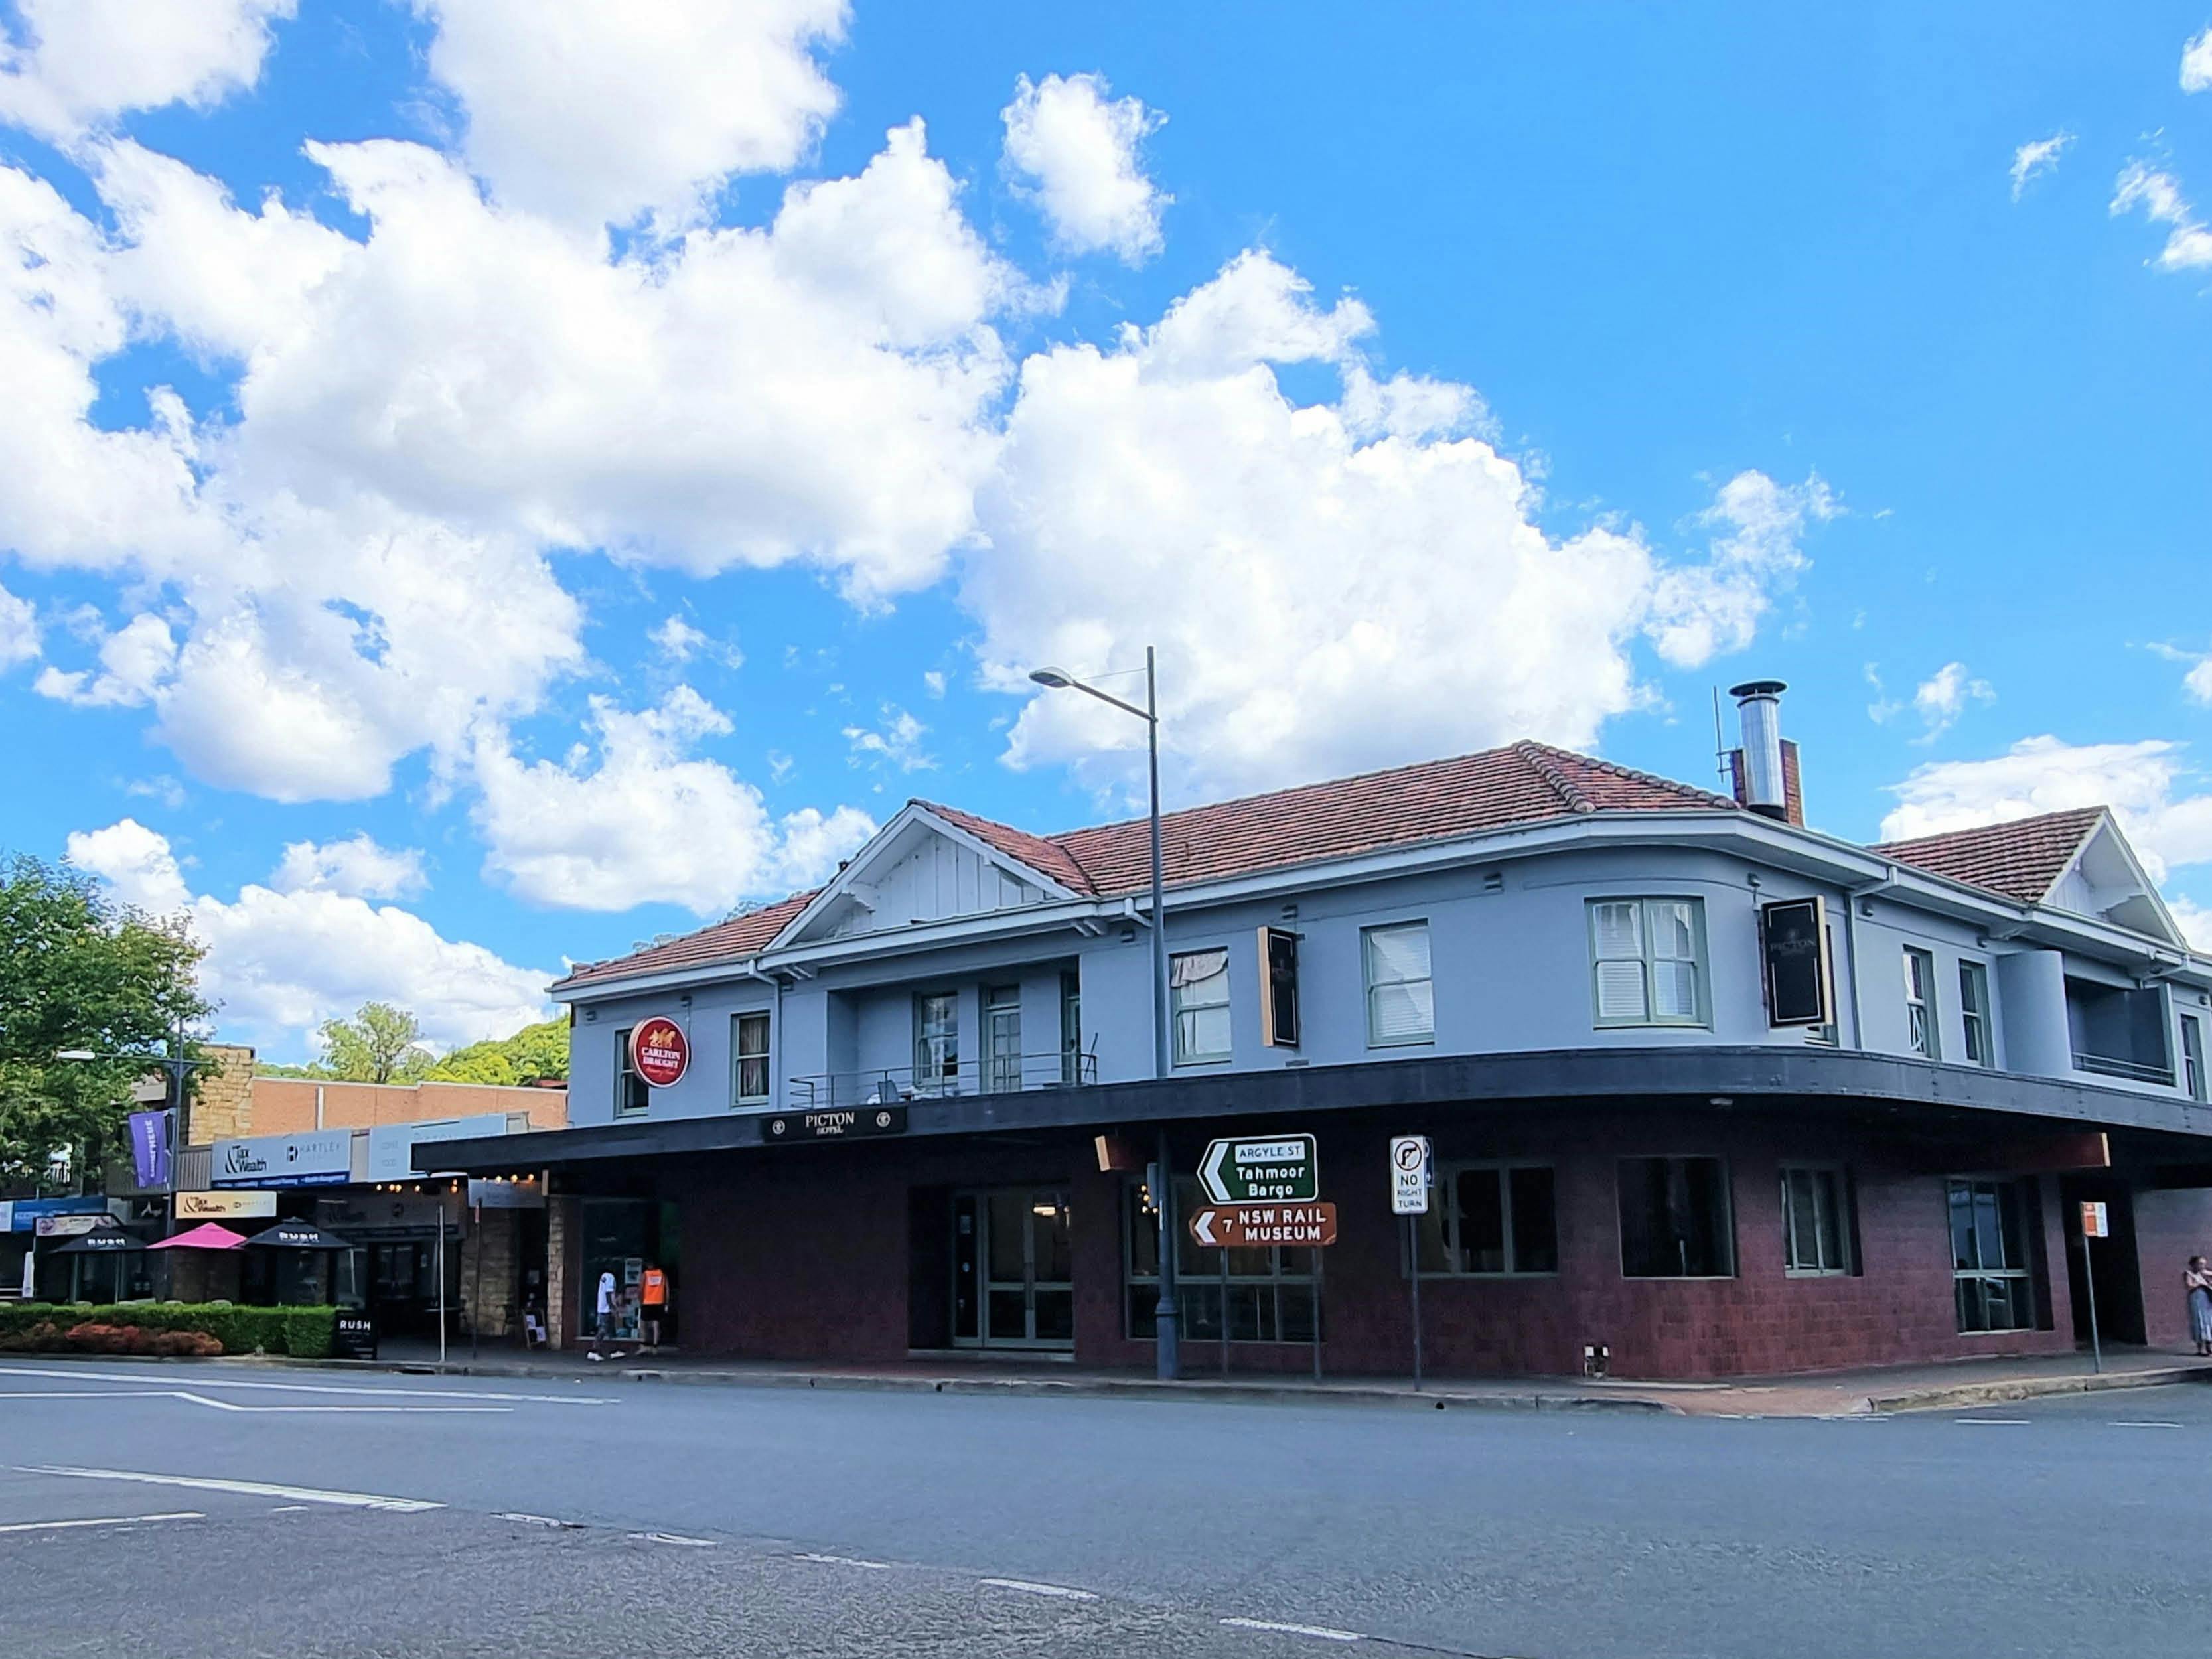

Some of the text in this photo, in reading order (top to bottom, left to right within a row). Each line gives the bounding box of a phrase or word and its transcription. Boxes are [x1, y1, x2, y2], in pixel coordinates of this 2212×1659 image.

[641, 1046, 681, 1060] CARLTON
[642, 1056, 678, 1069] DRAUGHT
[806, 1112, 855, 1127] PICTON
[816, 1126, 844, 1136] HOTEL
[232, 1145, 250, 1158] Tax
[1239, 1145, 1301, 1158] ARGYLE ST
[236, 1159, 267, 1173] Wealth
[1236, 1166, 1305, 1181] Tahmoor
[1400, 1174, 1418, 1186] NO
[1248, 1183, 1293, 1199] Bargo
[1222, 1208, 1327, 1233] 7 NSW RAIL
[1245, 1226, 1321, 1242] MUSEUM
[340, 1320, 371, 1331] RUSH
